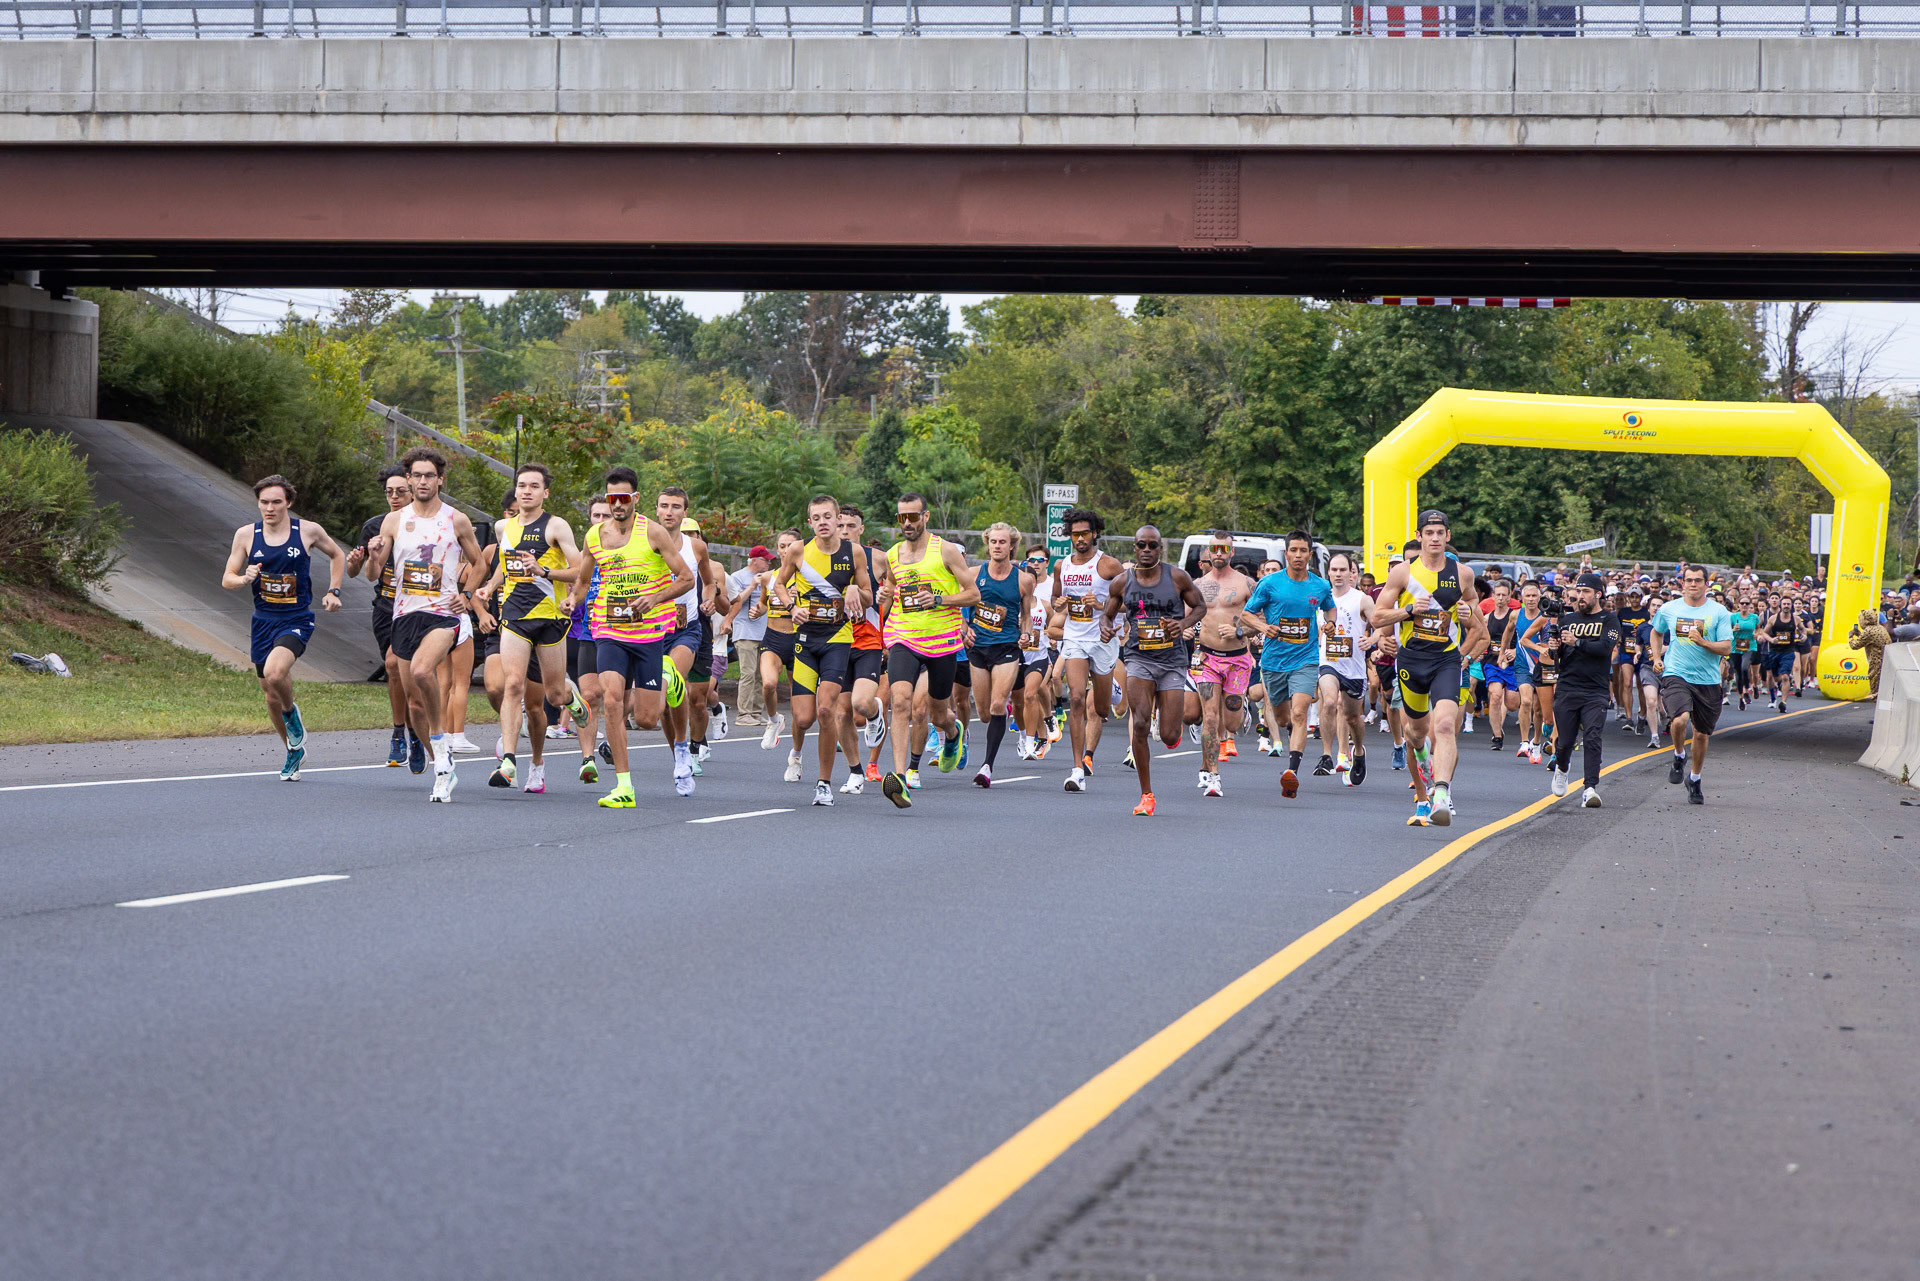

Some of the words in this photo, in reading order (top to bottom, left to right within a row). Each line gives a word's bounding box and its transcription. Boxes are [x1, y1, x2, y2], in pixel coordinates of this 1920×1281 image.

[1047, 489, 1074, 498] BY-PASS
[1050, 507, 1065, 518] SOU
[287, 546, 300, 558] SP
[1050, 546, 1070, 557] MILE
[833, 563, 851, 571] GSTC
[410, 572, 434, 584] 39
[264, 582, 292, 592] 137
[1440, 580, 1456, 588] GSTC
[620, 588, 640, 596] YORK
[614, 606, 634, 616] 94
[816, 608, 837, 617] 26
[1072, 604, 1086, 612] 27
[978, 608, 1000, 622] 198
[1422, 618, 1442, 629] 97
[1145, 628, 1164, 638] 75
[1280, 626, 1308, 634] 233
[1569, 622, 1603, 637] GOOD
[1328, 644, 1350, 652] 212
